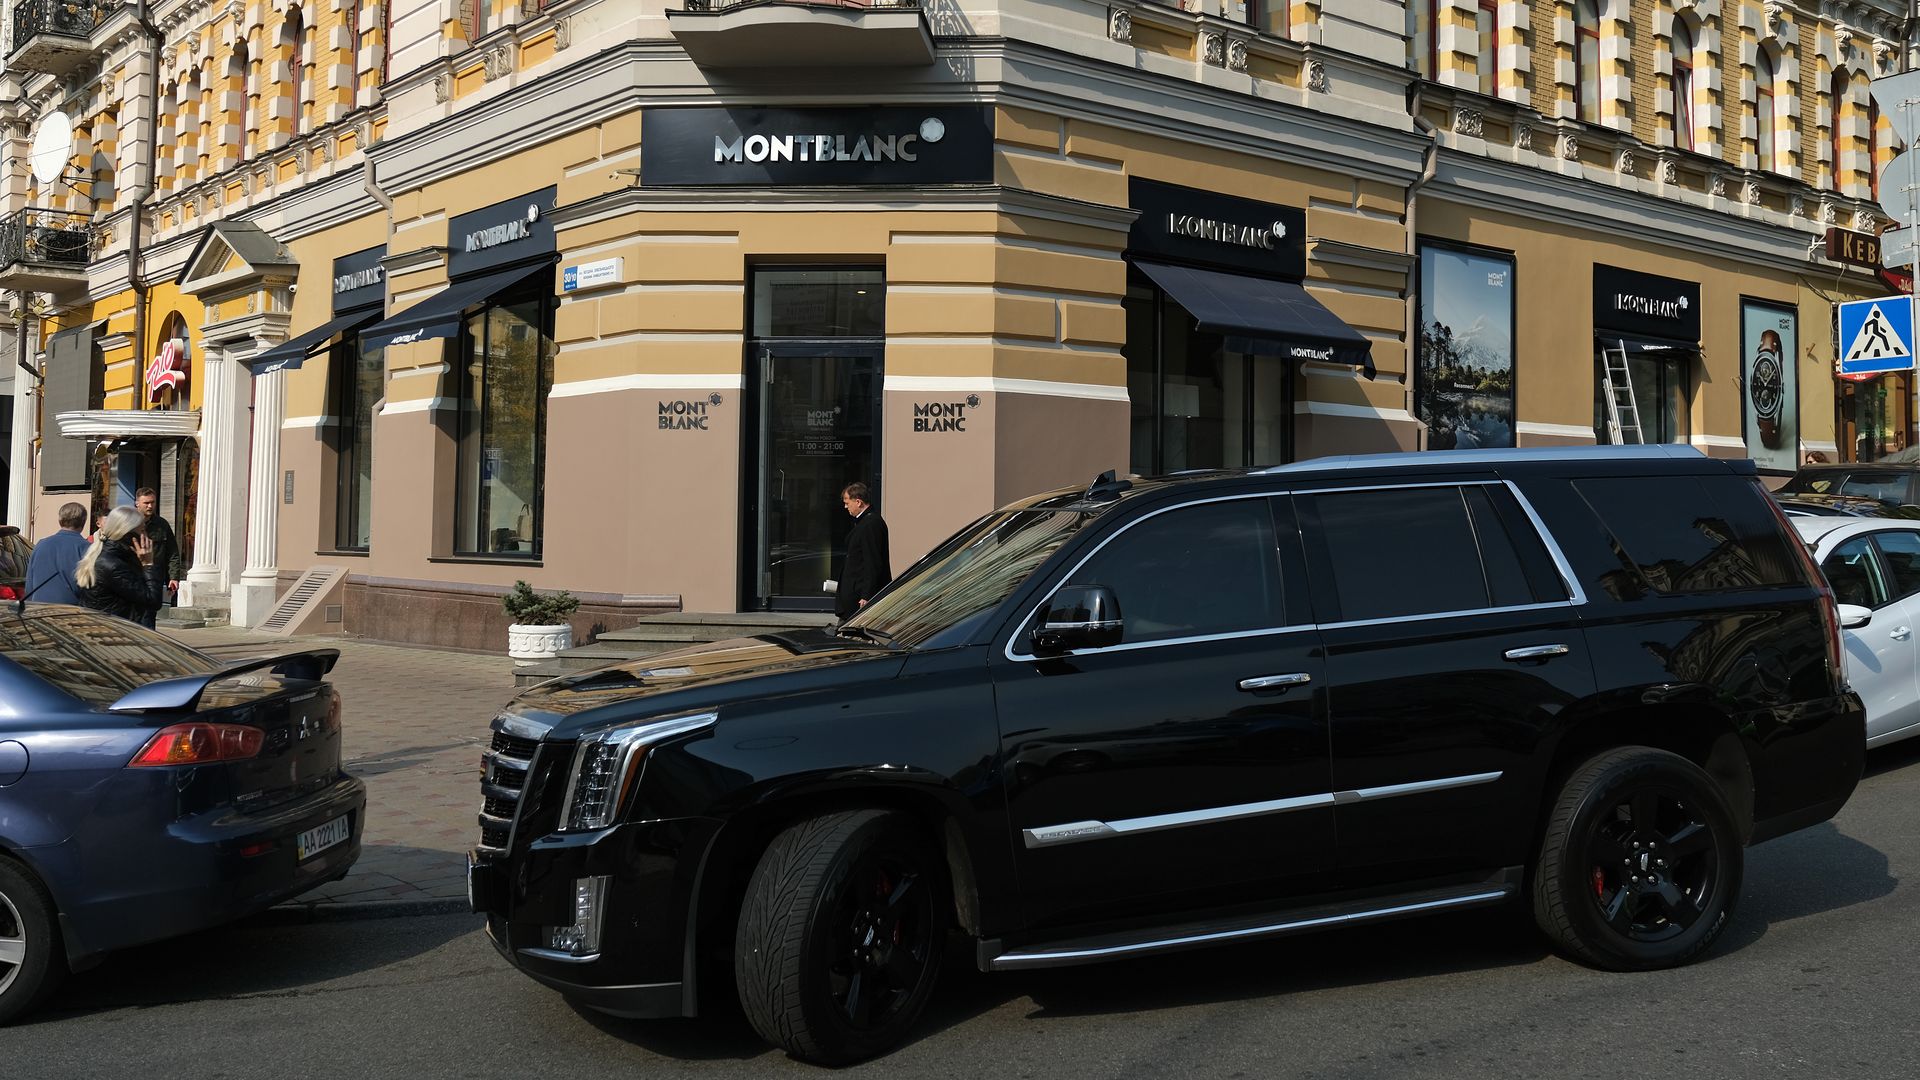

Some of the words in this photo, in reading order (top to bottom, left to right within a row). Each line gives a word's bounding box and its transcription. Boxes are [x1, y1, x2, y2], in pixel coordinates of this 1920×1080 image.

[714, 134, 918, 163] MONTBLANC
[465, 218, 531, 253] MONTBLANC
[1166, 212, 1275, 251] MONTBLANC
[1614, 292, 1682, 320] MONTBLANC
[1290, 346, 1330, 361] MONTBLANC
[658, 400, 709, 416] MONT
[807, 410, 835, 418] MONT
[913, 402, 966, 418] MONT
[658, 415, 709, 431] BLANC
[807, 418, 835, 426] BLANC
[913, 417, 966, 433] BLANC
[796, 442, 817, 450] 11:00
[823, 442, 844, 450] 21:00
[304, 831, 317, 855] AA
[317, 823, 336, 849] 2221
[1040, 826, 1101, 838] ESCALADE
